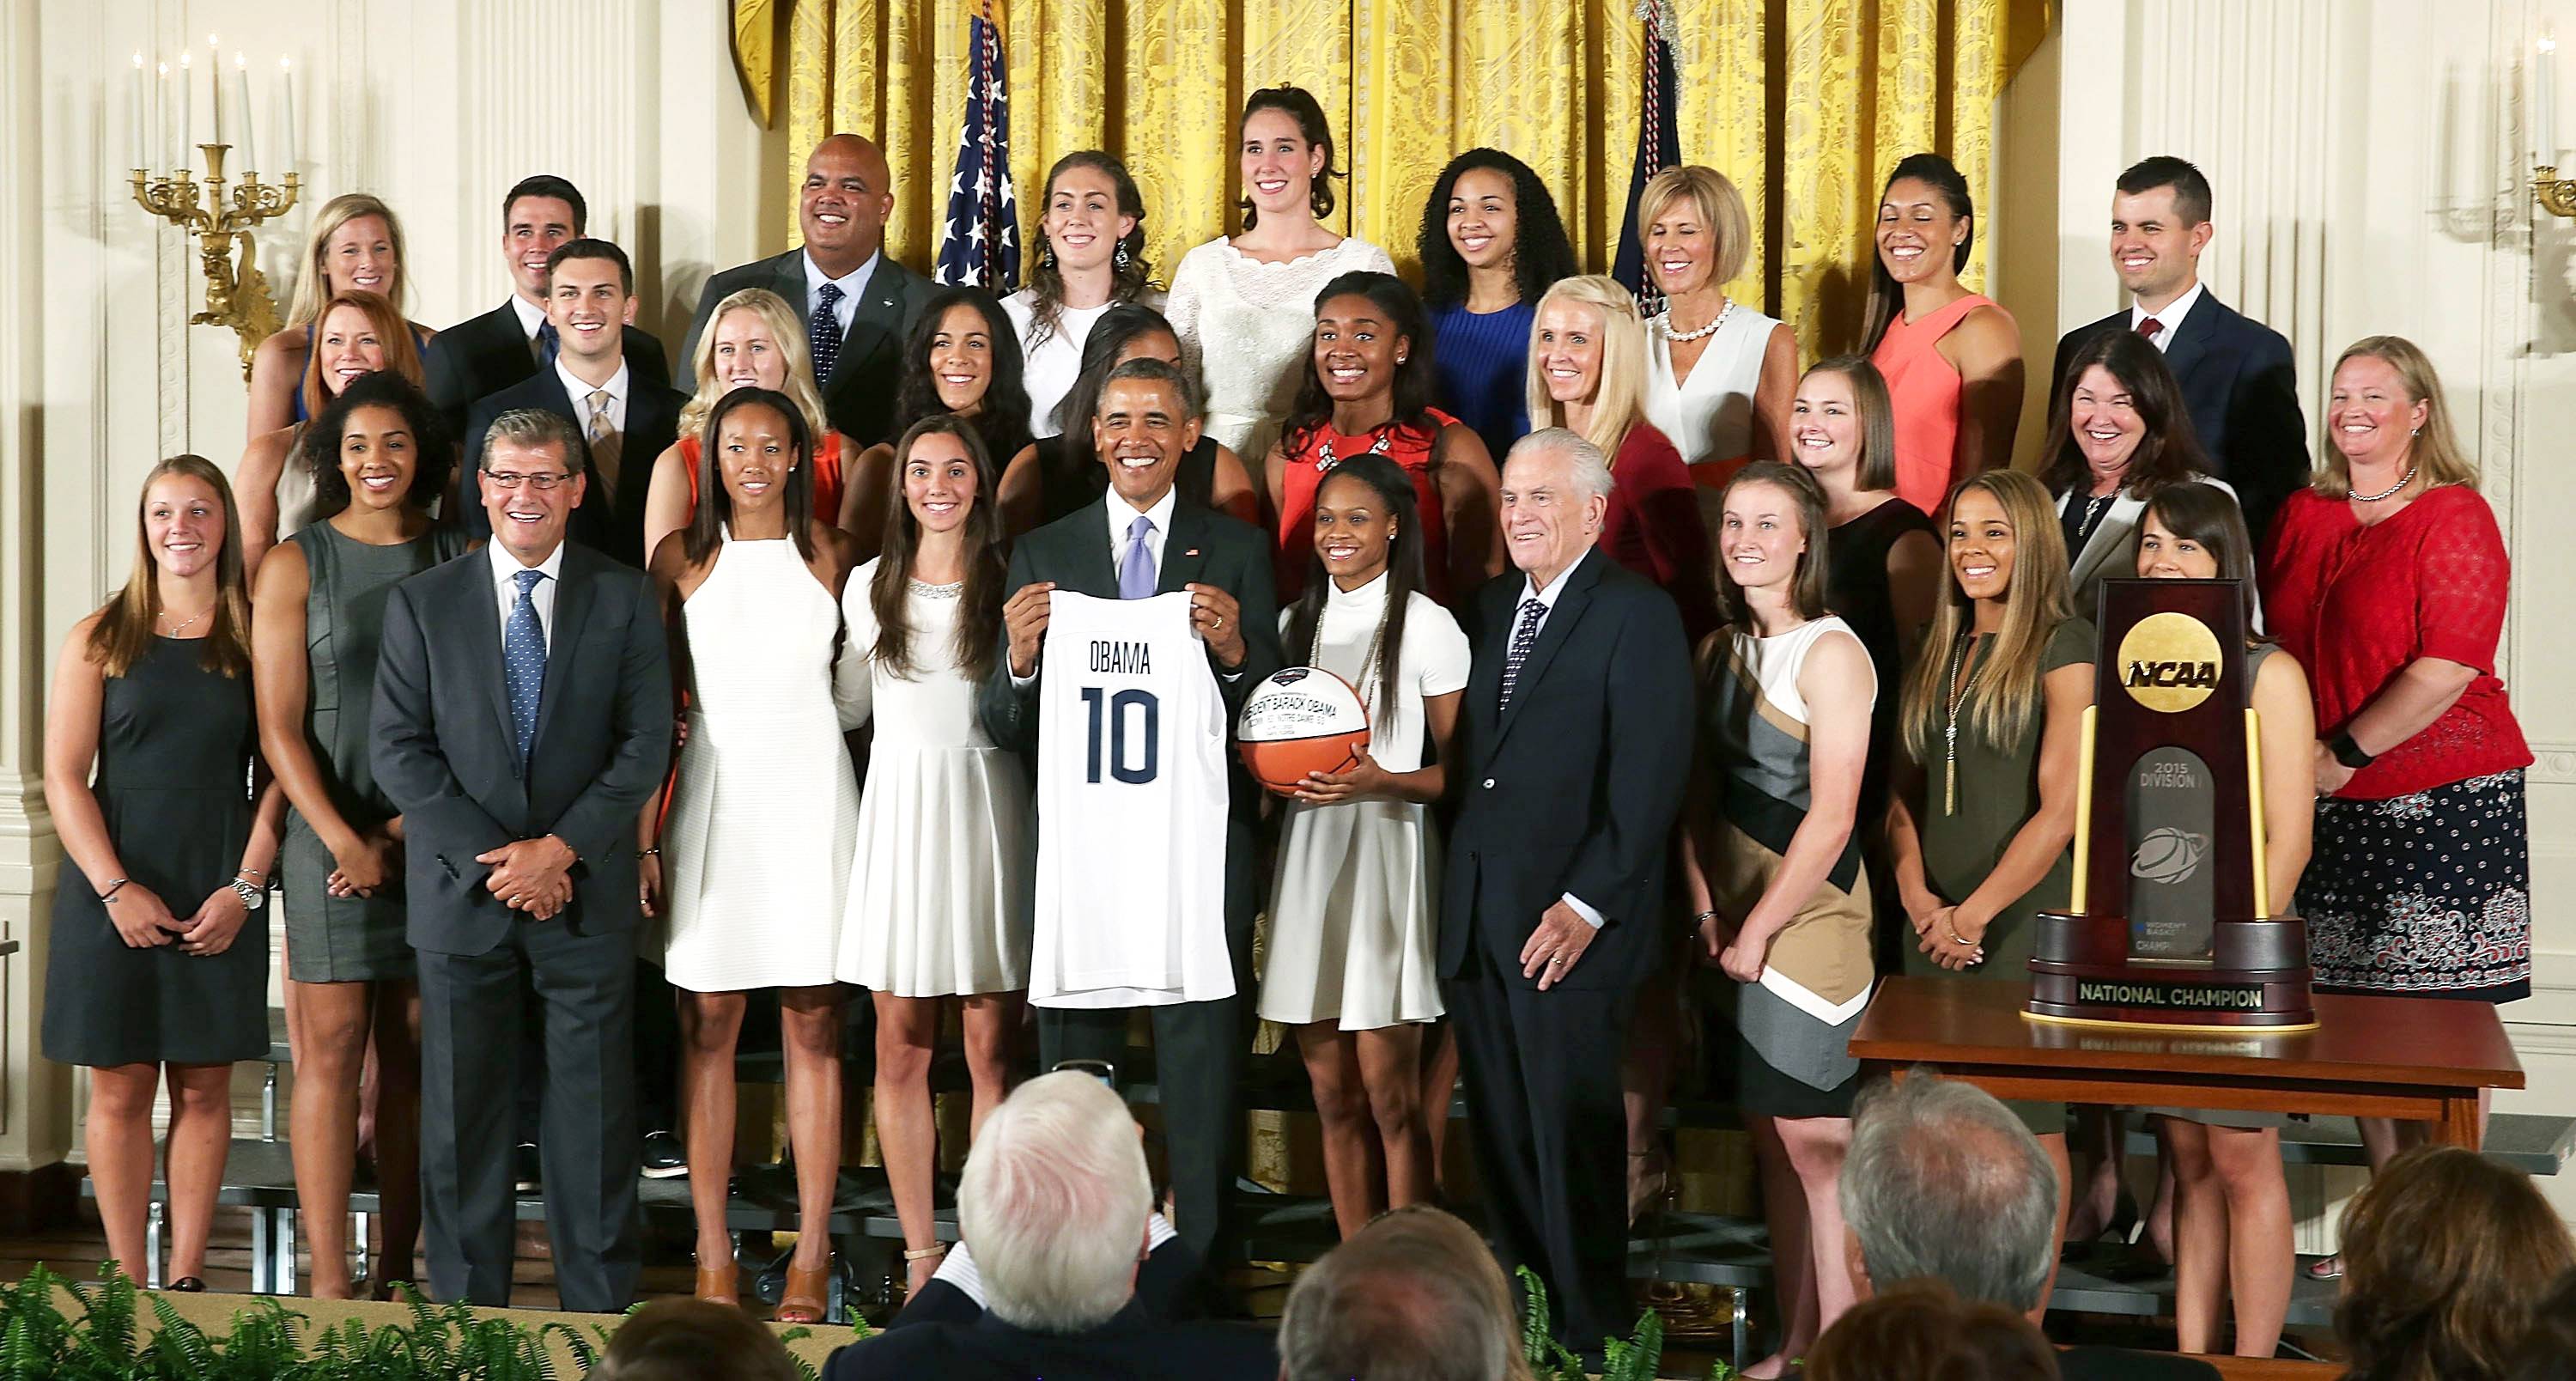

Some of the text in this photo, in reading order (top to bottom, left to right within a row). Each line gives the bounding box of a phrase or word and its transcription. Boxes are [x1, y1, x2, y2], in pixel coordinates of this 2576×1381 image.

[1090, 640, 1151, 675] OBAMA
[2125, 660, 2215, 688] NCAA
[1273, 697, 1306, 710] BARACK
[1308, 699, 1336, 719] OBAMA
[1081, 687, 1159, 785] 10
[2140, 772, 2196, 788] DIVISION
[2154, 763, 2189, 774] 2015
[2080, 983, 2263, 1008] NATIONAL CHAMPION
